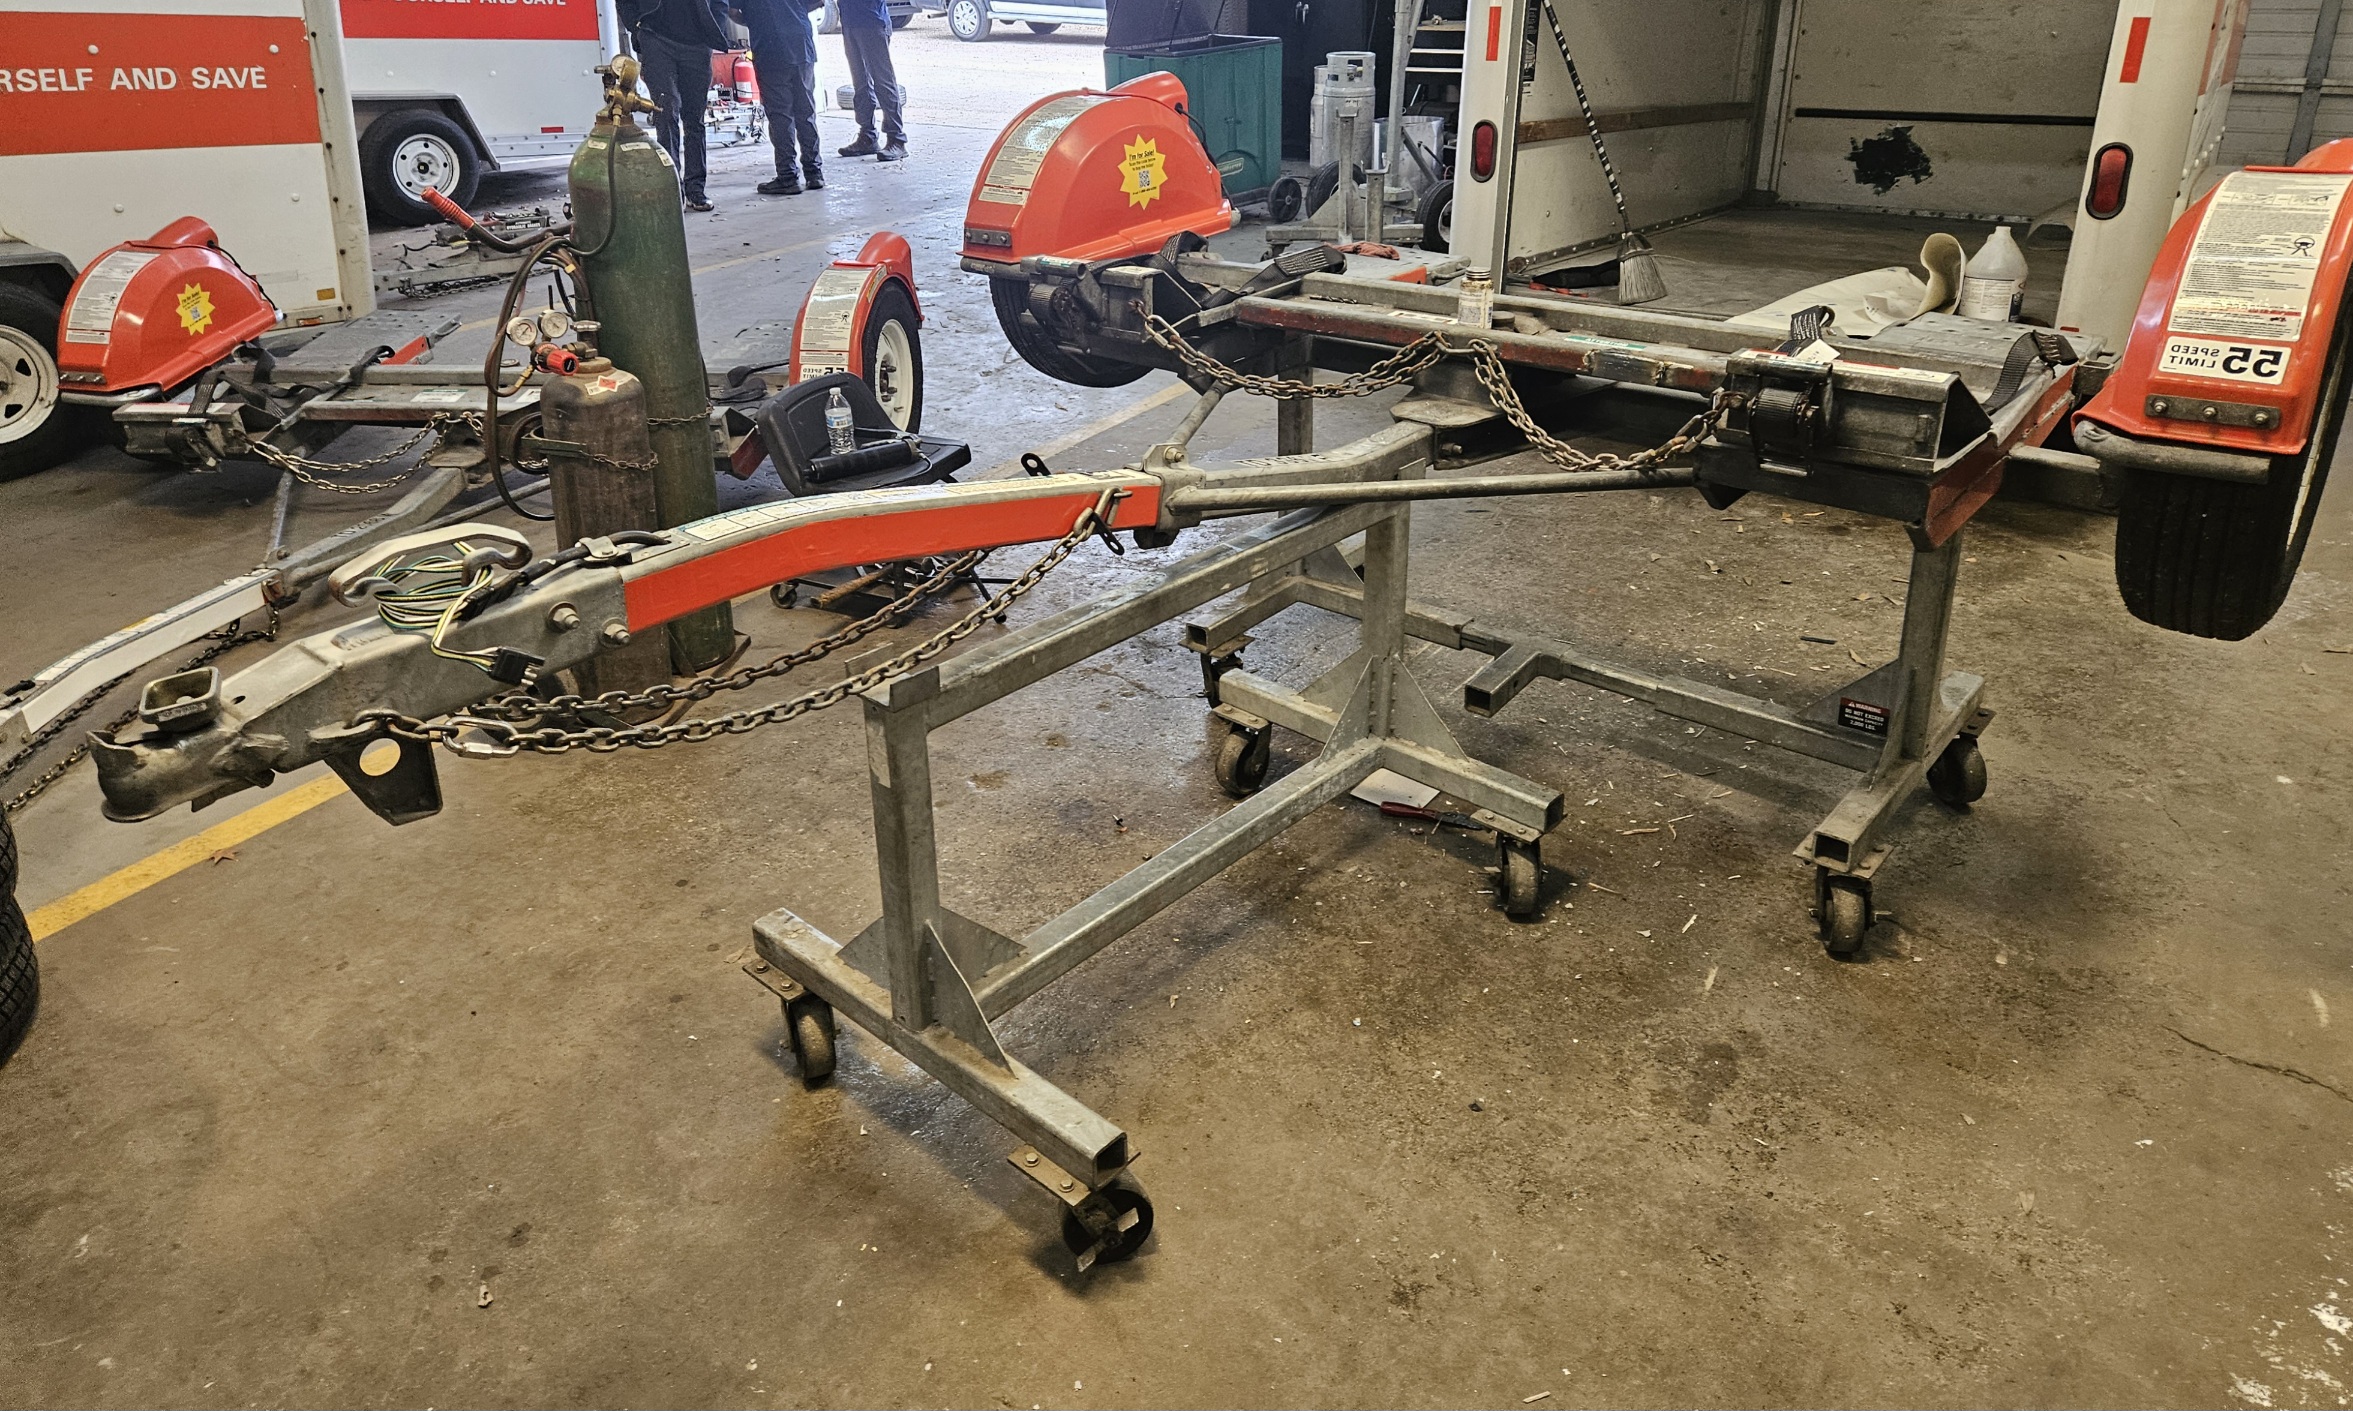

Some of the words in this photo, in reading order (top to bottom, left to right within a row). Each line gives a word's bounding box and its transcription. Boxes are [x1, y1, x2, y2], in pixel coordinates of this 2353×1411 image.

[110, 67, 177, 90] AND
[191, 66, 267, 89] SAVE
[1855, 703, 1882, 714] WARNING
[1864, 713, 1884, 722] EXCEED
